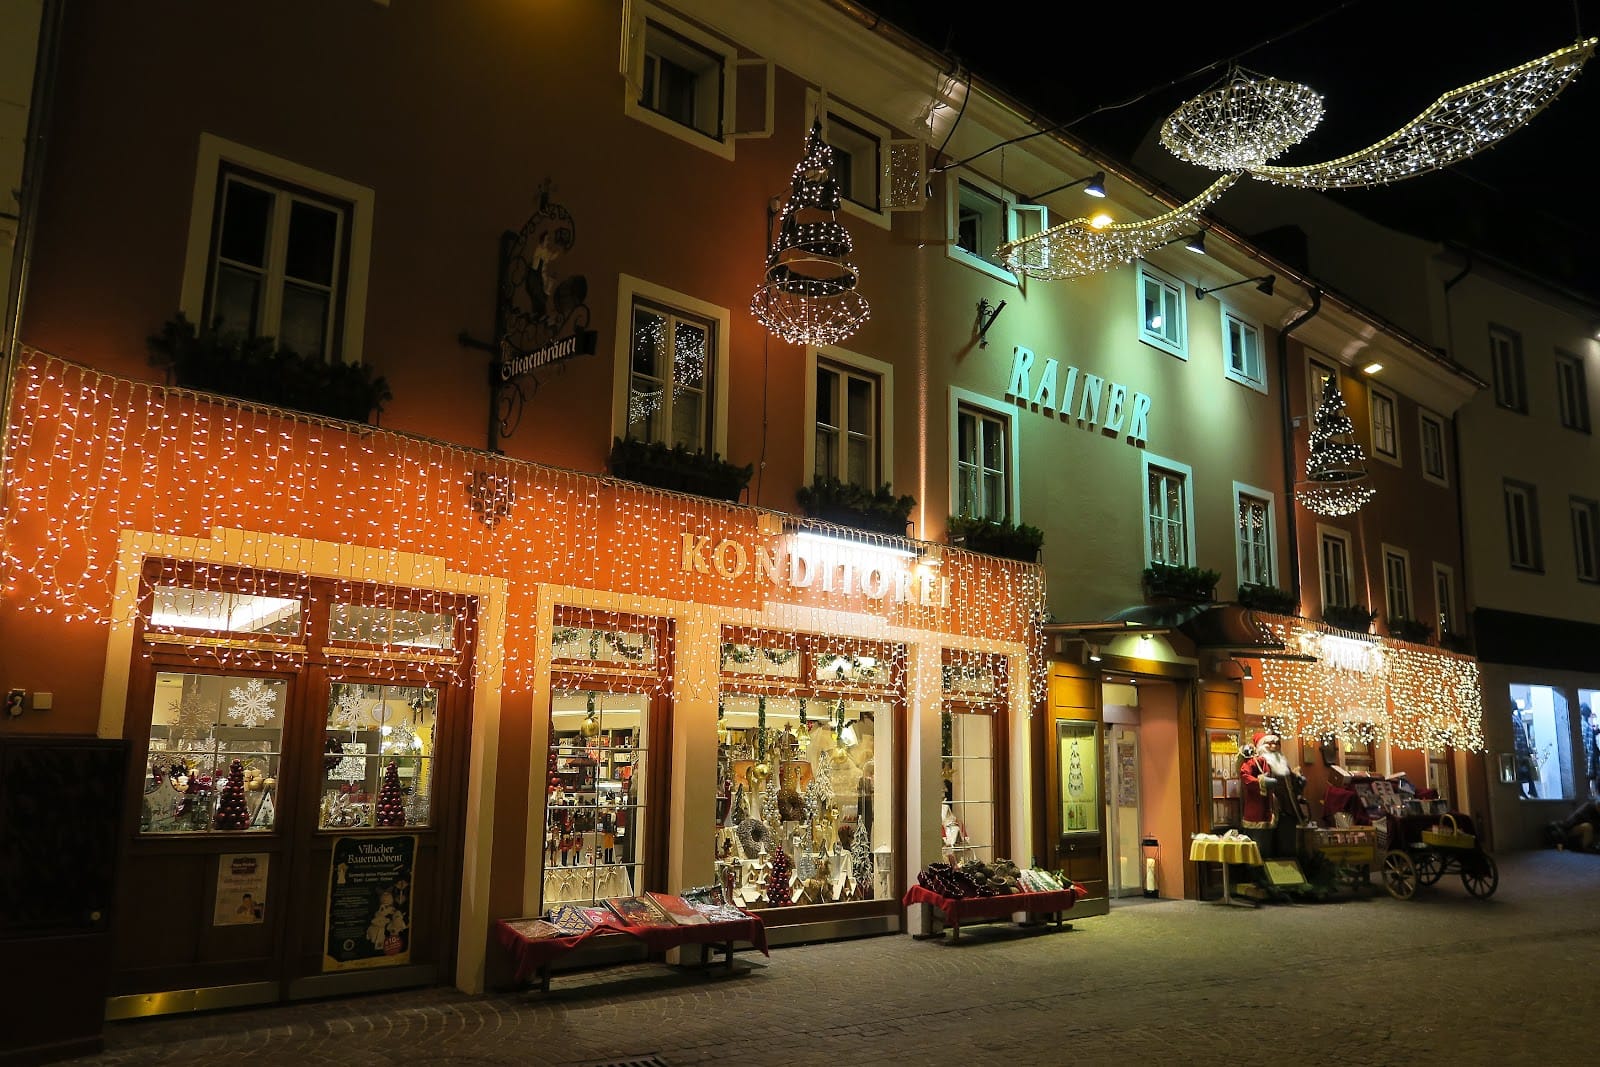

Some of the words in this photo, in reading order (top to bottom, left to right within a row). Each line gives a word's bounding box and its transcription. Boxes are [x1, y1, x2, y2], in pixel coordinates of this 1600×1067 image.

[1005, 345, 1151, 441] RAINER
[681, 533, 949, 608] KONDITOREI
[347, 854, 403, 864] Bauernadvent
[358, 844, 395, 855] Villacher
